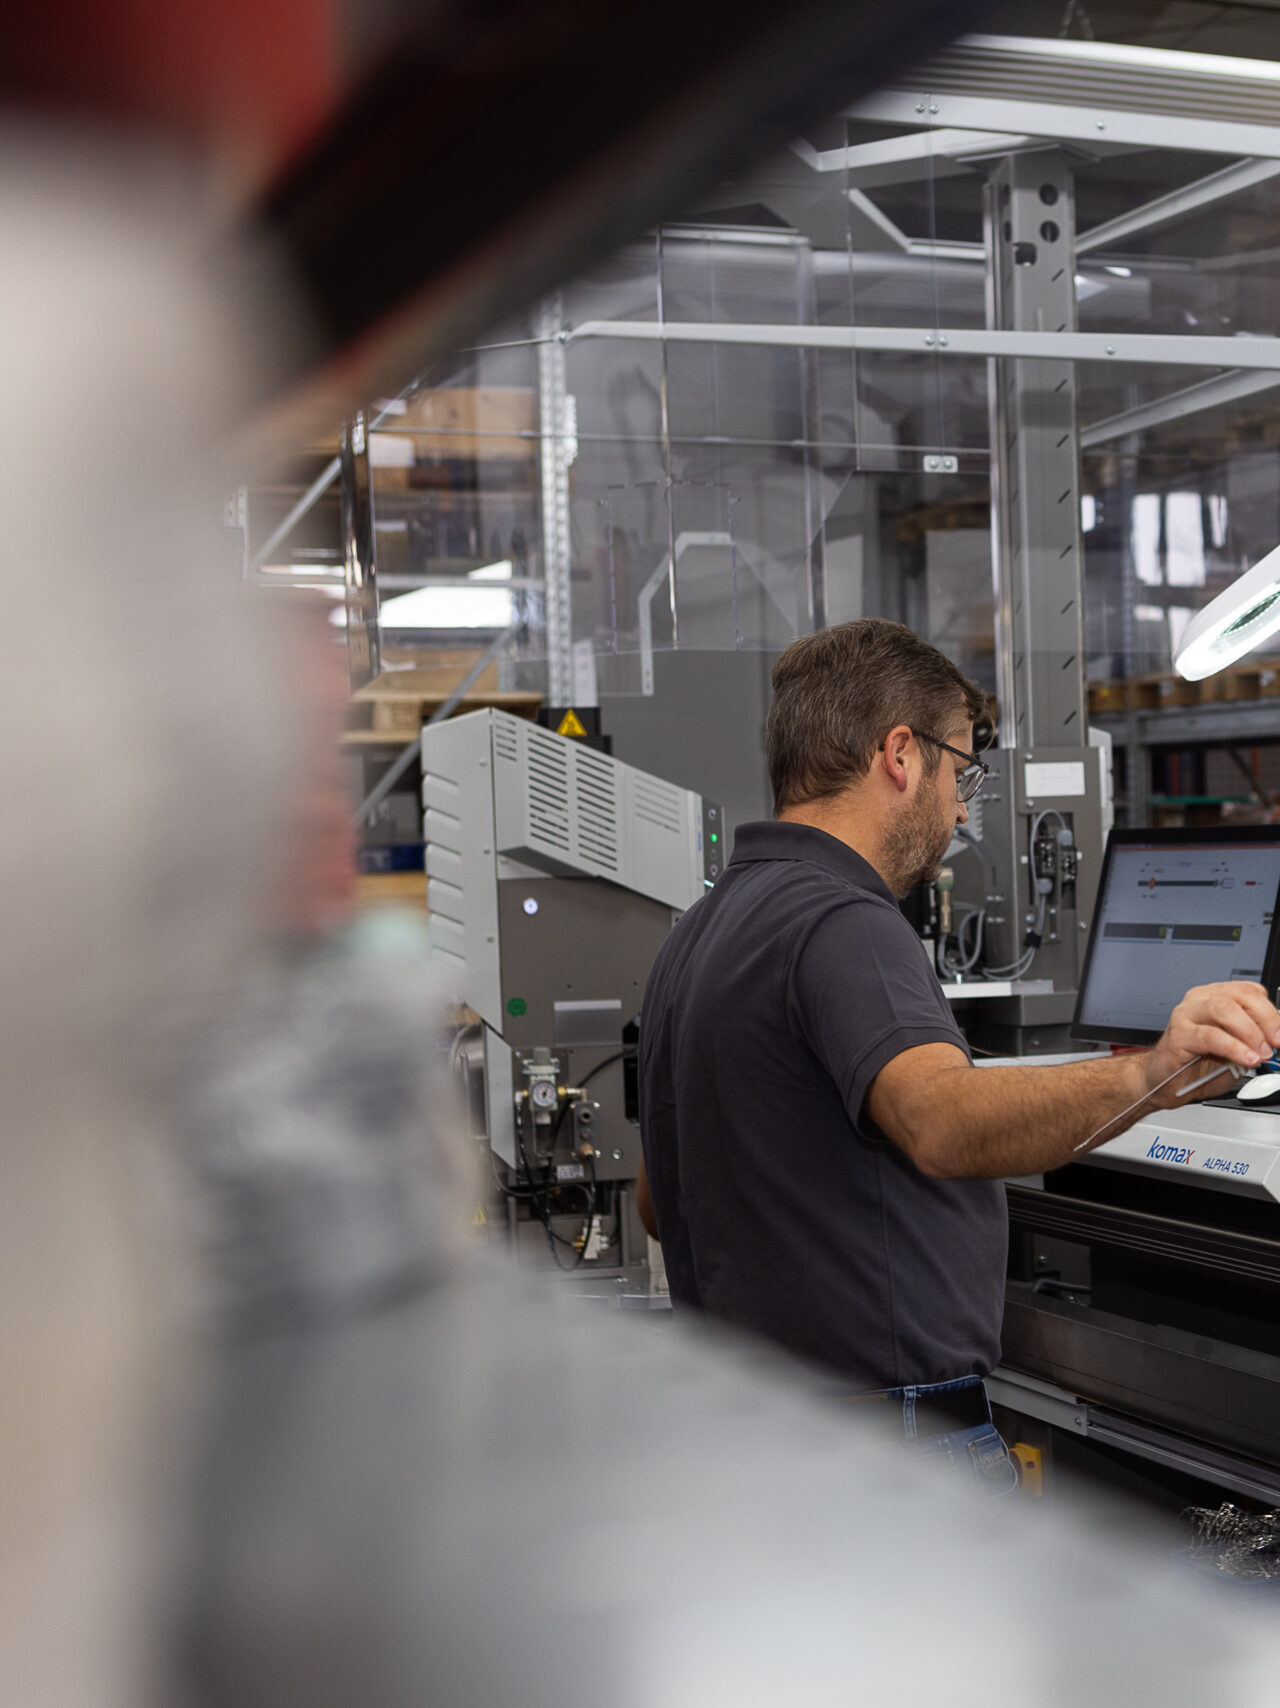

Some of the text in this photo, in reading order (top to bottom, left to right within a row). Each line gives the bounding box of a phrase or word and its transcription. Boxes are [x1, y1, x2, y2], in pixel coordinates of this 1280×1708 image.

[1146, 1135, 1250, 1175] komax ALPHA 530
